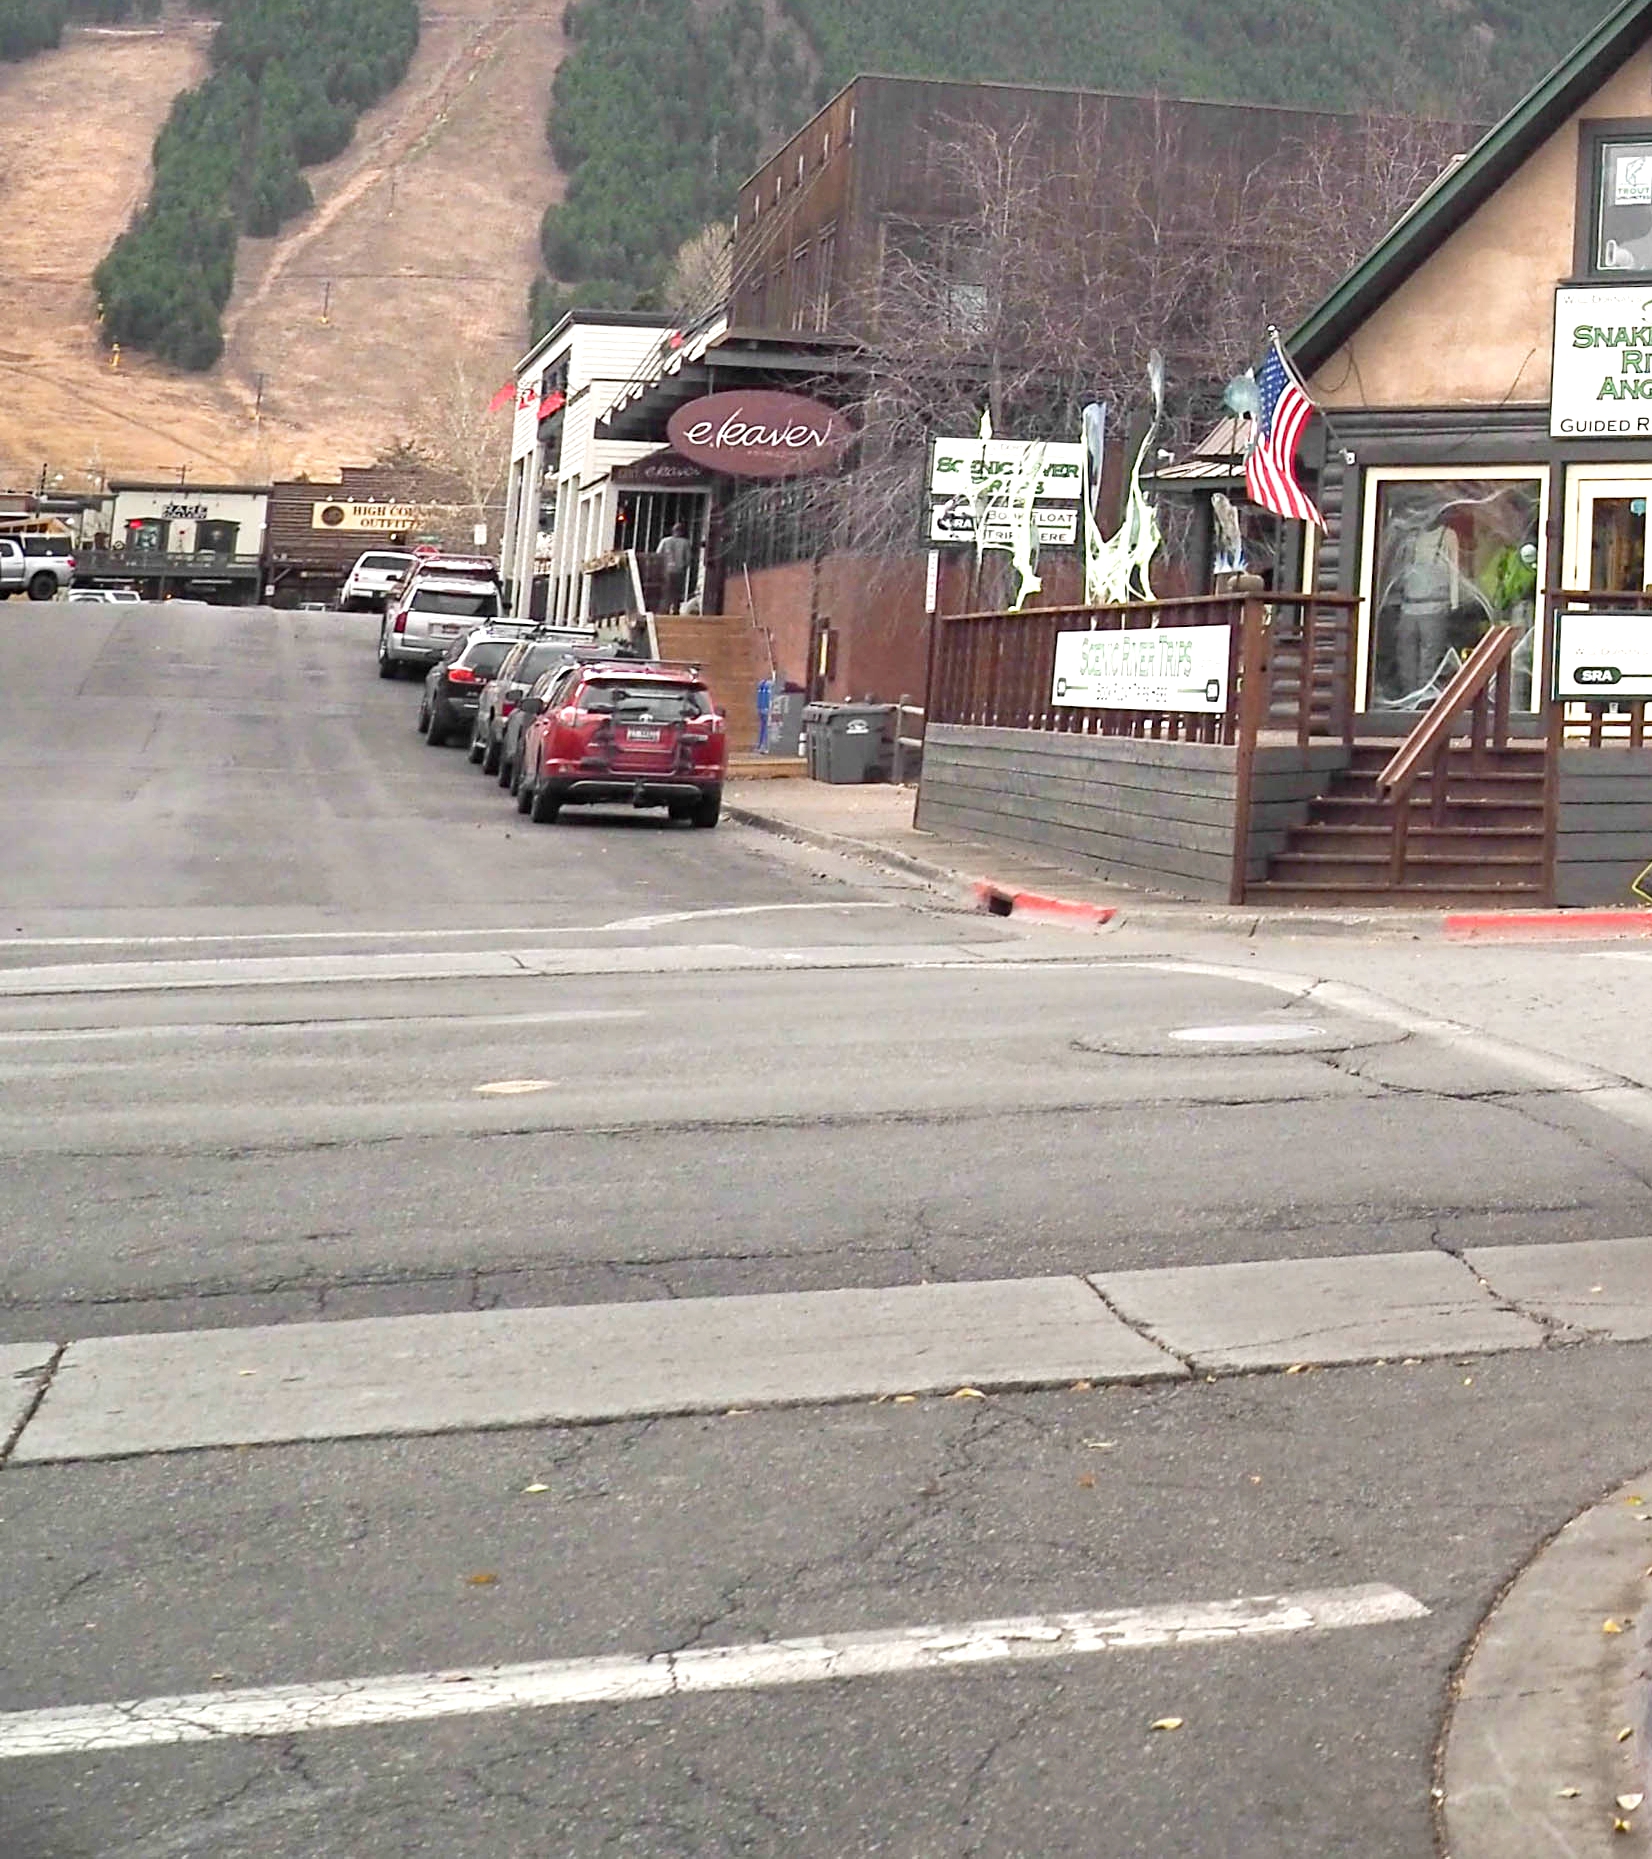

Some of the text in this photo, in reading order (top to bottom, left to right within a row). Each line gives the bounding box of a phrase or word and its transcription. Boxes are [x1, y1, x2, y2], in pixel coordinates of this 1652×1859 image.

[1560, 418, 1631, 432] GUIDED
[352, 506, 386, 517] HIGH
[1040, 533, 1068, 542] ERE
[1159, 635, 1193, 677] TRIPS
[1581, 670, 1613, 682] SRA
